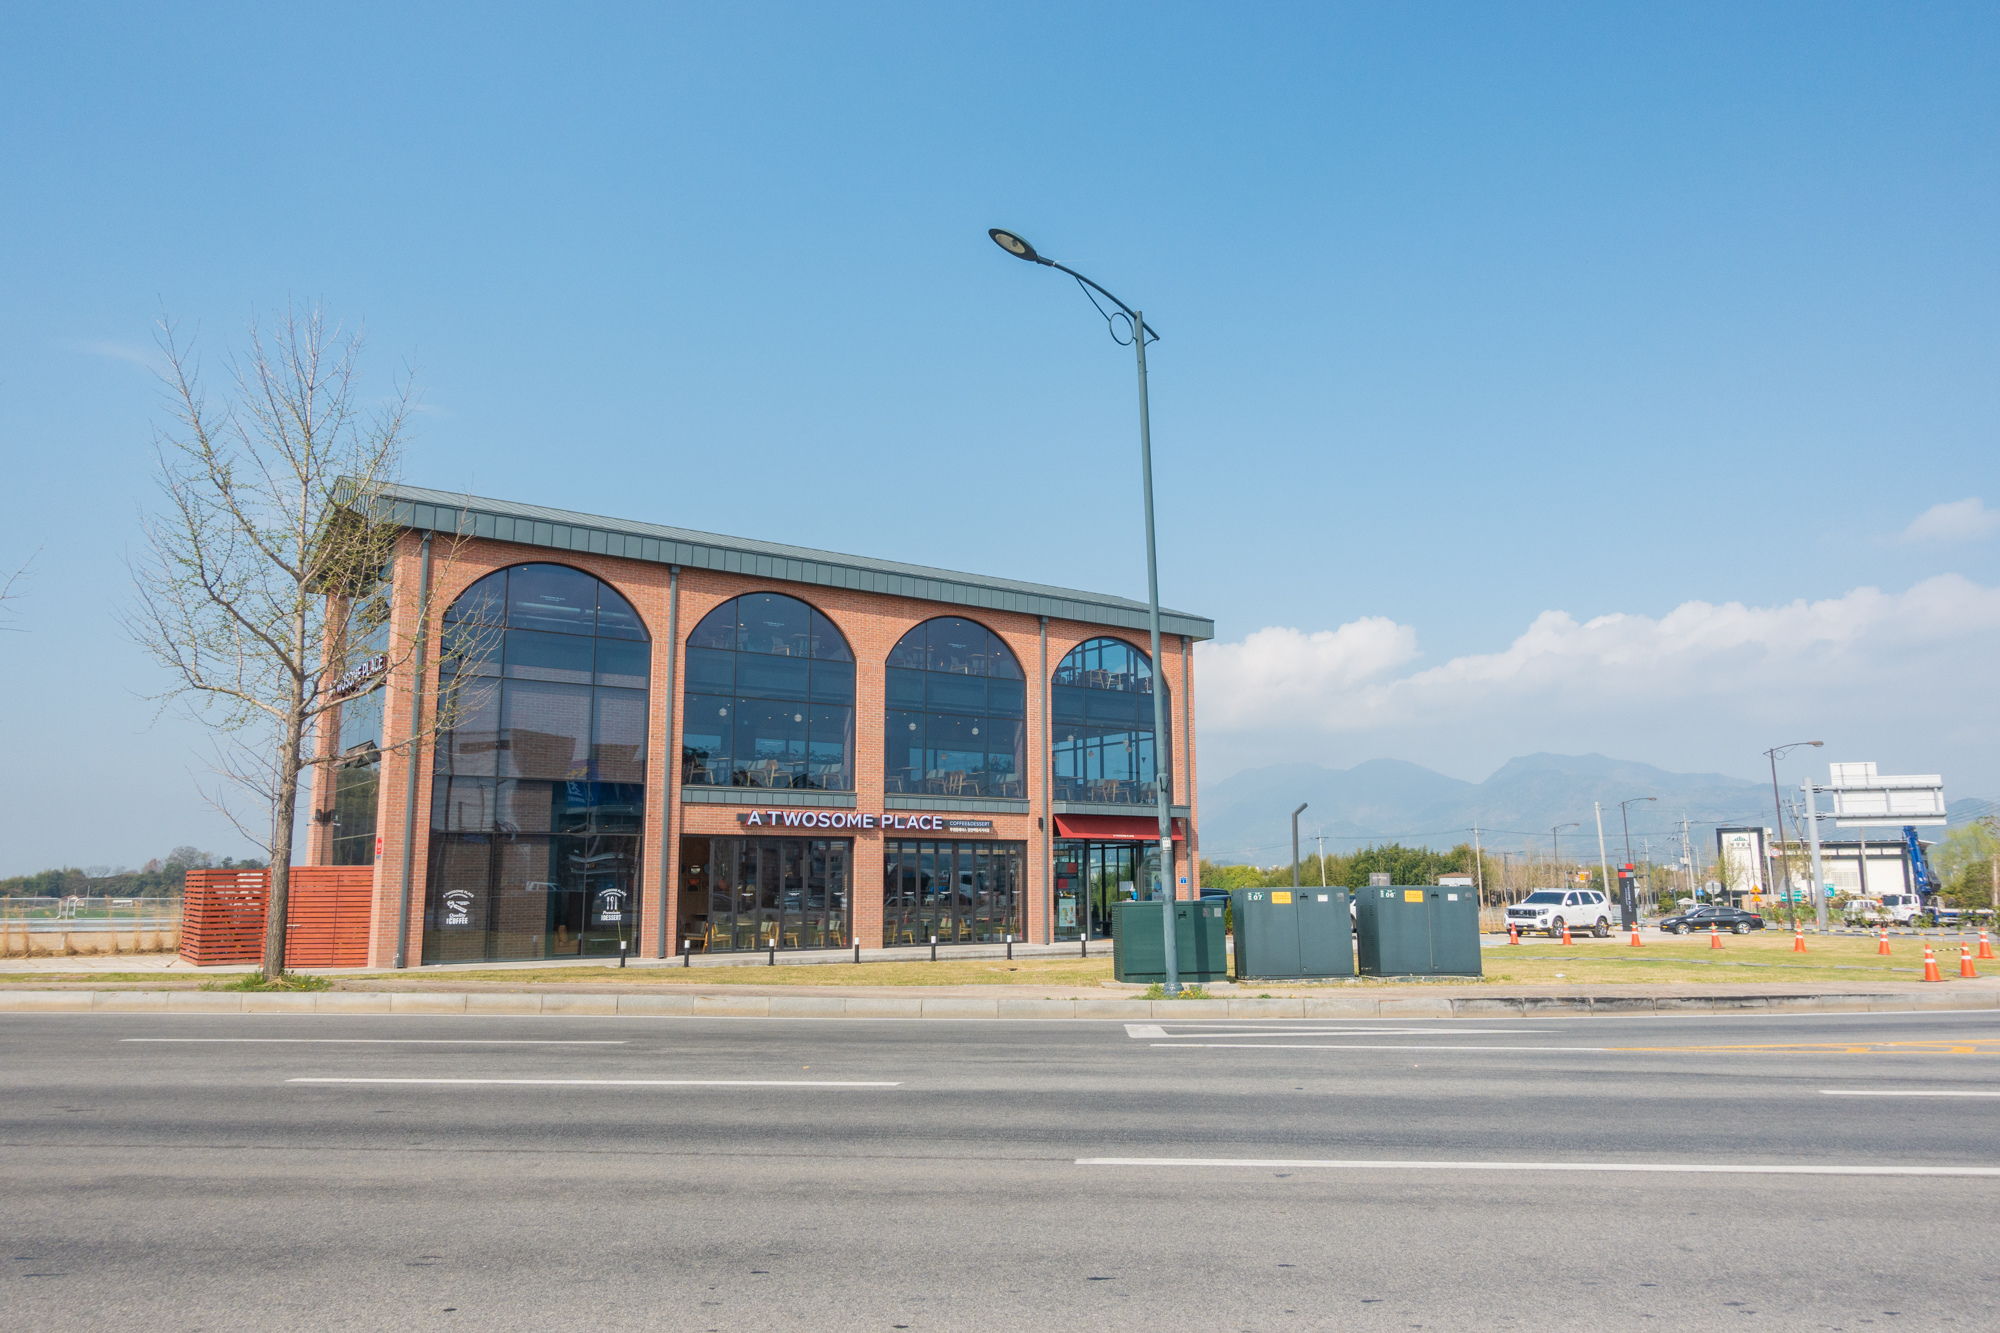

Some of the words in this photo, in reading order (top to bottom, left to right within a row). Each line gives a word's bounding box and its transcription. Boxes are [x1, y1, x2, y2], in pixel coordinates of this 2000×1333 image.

[746, 810, 762, 826] A
[766, 811, 874, 829] TWOSOME
[880, 814, 943, 830] PLACE
[449, 917, 469, 925] COFFEE
